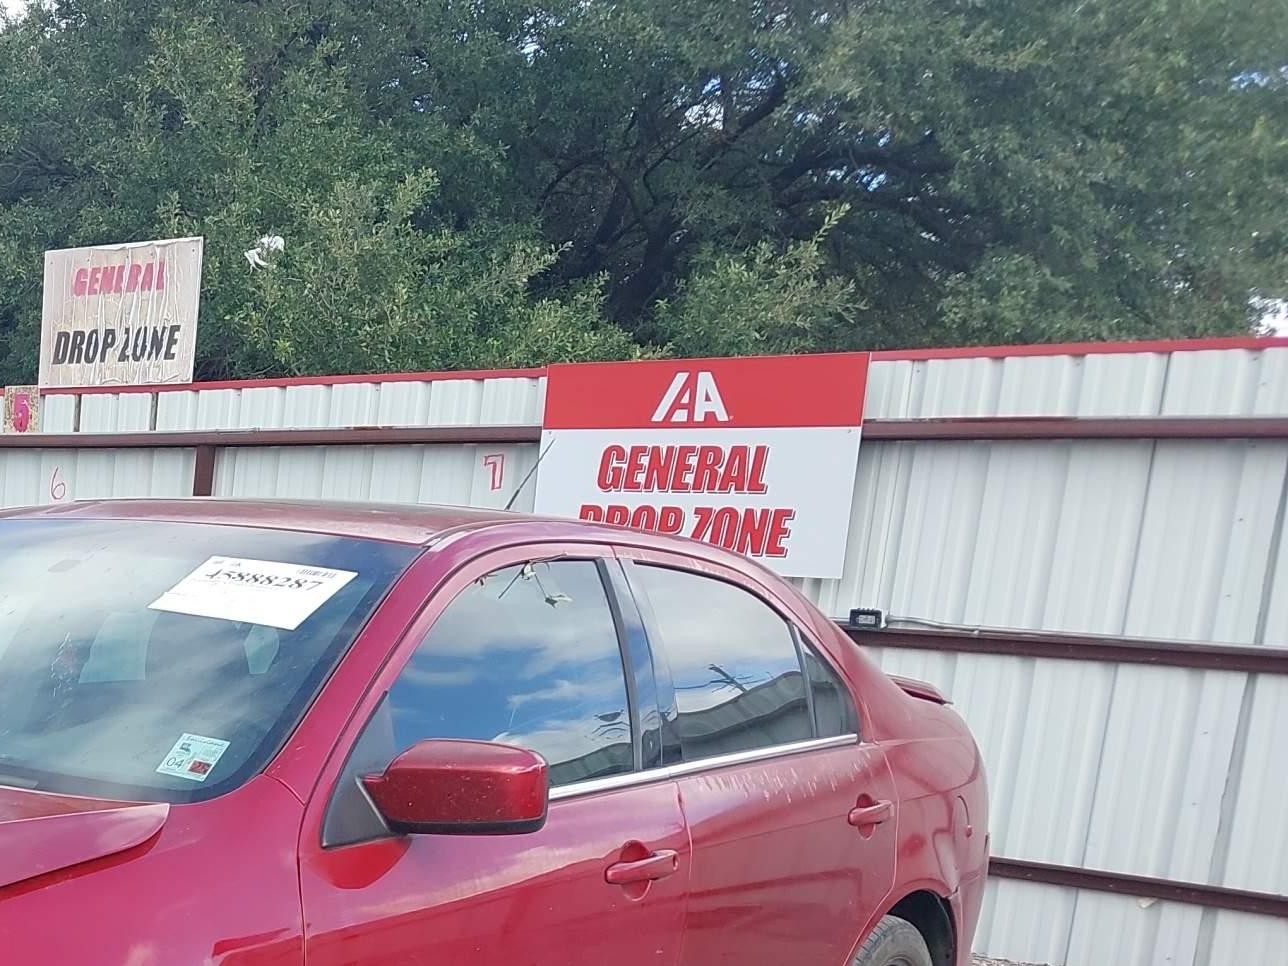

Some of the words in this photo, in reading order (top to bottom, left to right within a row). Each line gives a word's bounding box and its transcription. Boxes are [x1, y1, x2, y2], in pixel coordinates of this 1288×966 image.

[73, 262, 165, 297] GENERAL
[52, 328, 116, 366] DROP
[117, 324, 181, 363] ZONE
[50, 465, 66, 501] 6
[597, 444, 770, 495] GENERAL
[690, 506, 795, 558] ZONE
[204, 568, 324, 592] 45888287
[166, 756, 185, 769] 04
